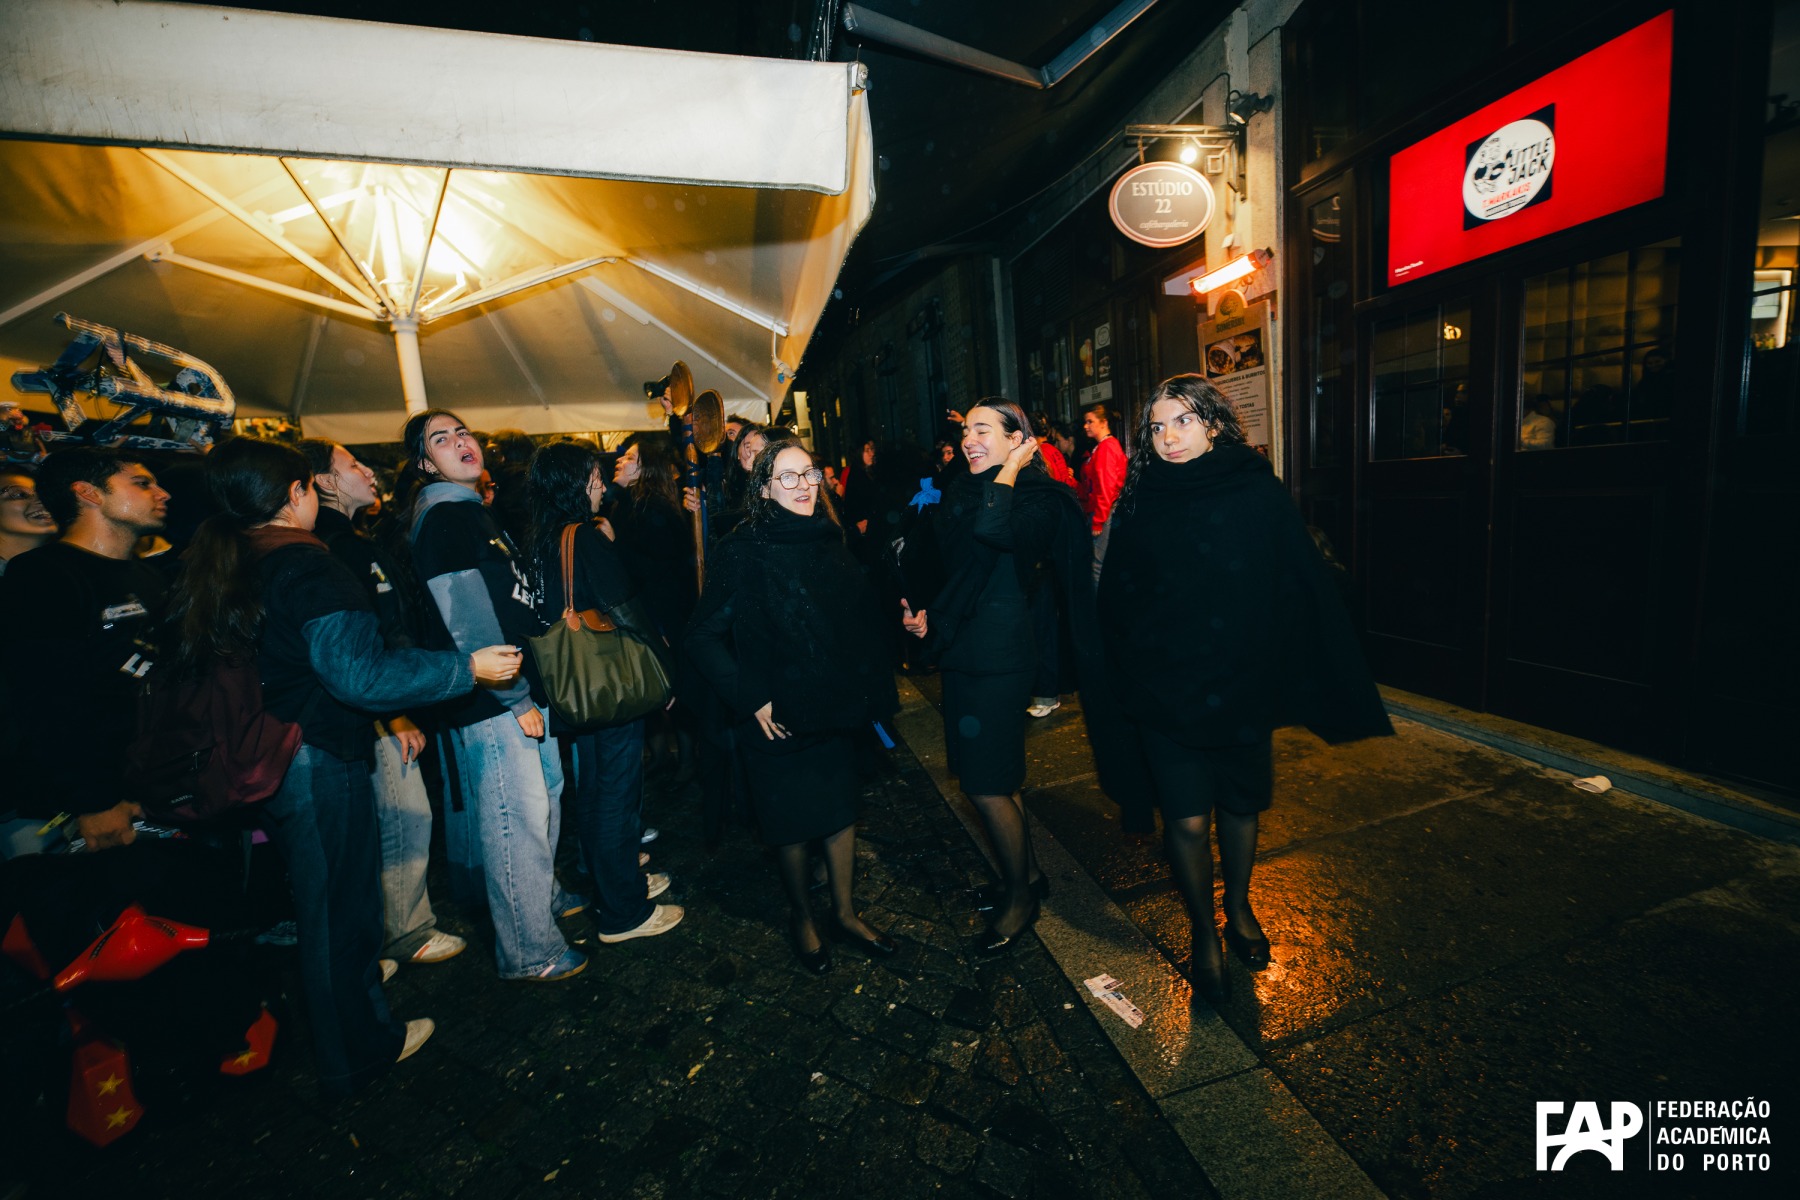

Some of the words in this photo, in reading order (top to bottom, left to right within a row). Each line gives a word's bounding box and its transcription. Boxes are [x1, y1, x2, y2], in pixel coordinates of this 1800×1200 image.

[1508, 153, 1549, 185] JACK
[1131, 179, 1193, 196] ESTÚDIO
[1155, 198, 1172, 214] 22
